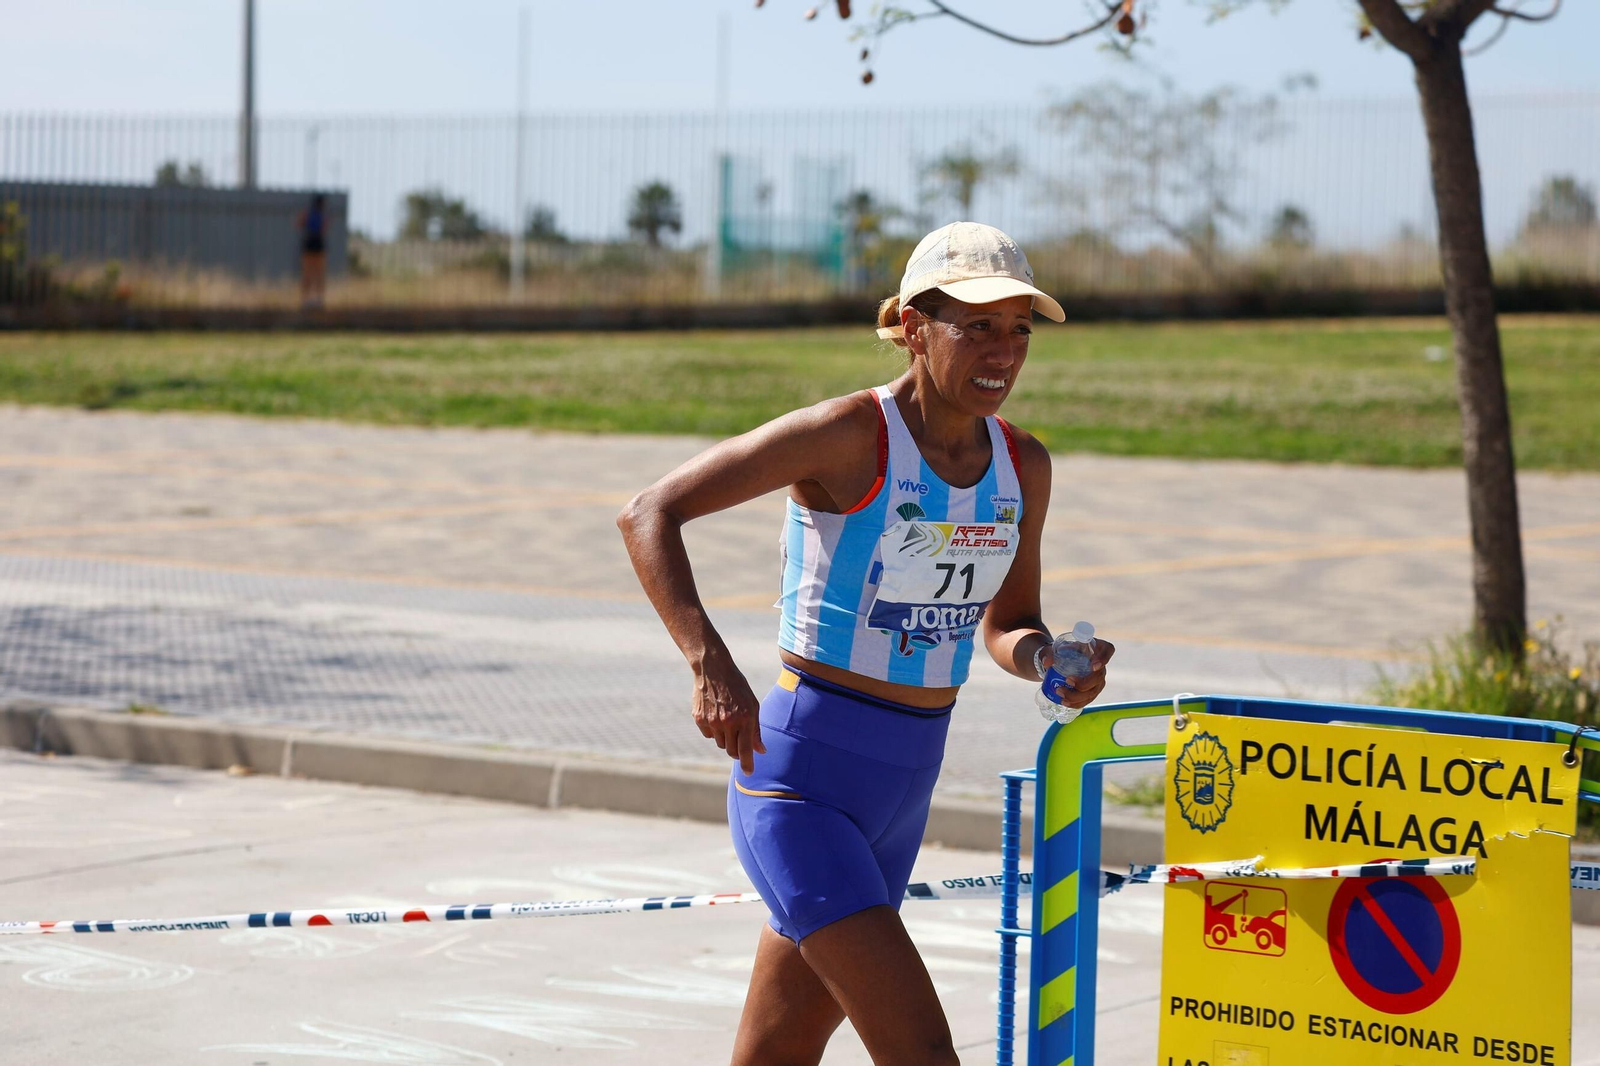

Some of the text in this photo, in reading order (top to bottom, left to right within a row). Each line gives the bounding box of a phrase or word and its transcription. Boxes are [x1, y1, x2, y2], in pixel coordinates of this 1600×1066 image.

[897, 479, 929, 495] vive
[954, 525, 996, 539] RFEA
[946, 549, 974, 558] RUTA
[933, 563, 975, 599] 71
[1240, 739, 1564, 806] POLICÍA LOCAL
[1304, 800, 1489, 859] MÁLAGA
[942, 876, 987, 889] PASO
[346, 911, 387, 924] LOCAL
[1170, 996, 1556, 1066] PROHIBIDO ESTACIONAR DESDE
